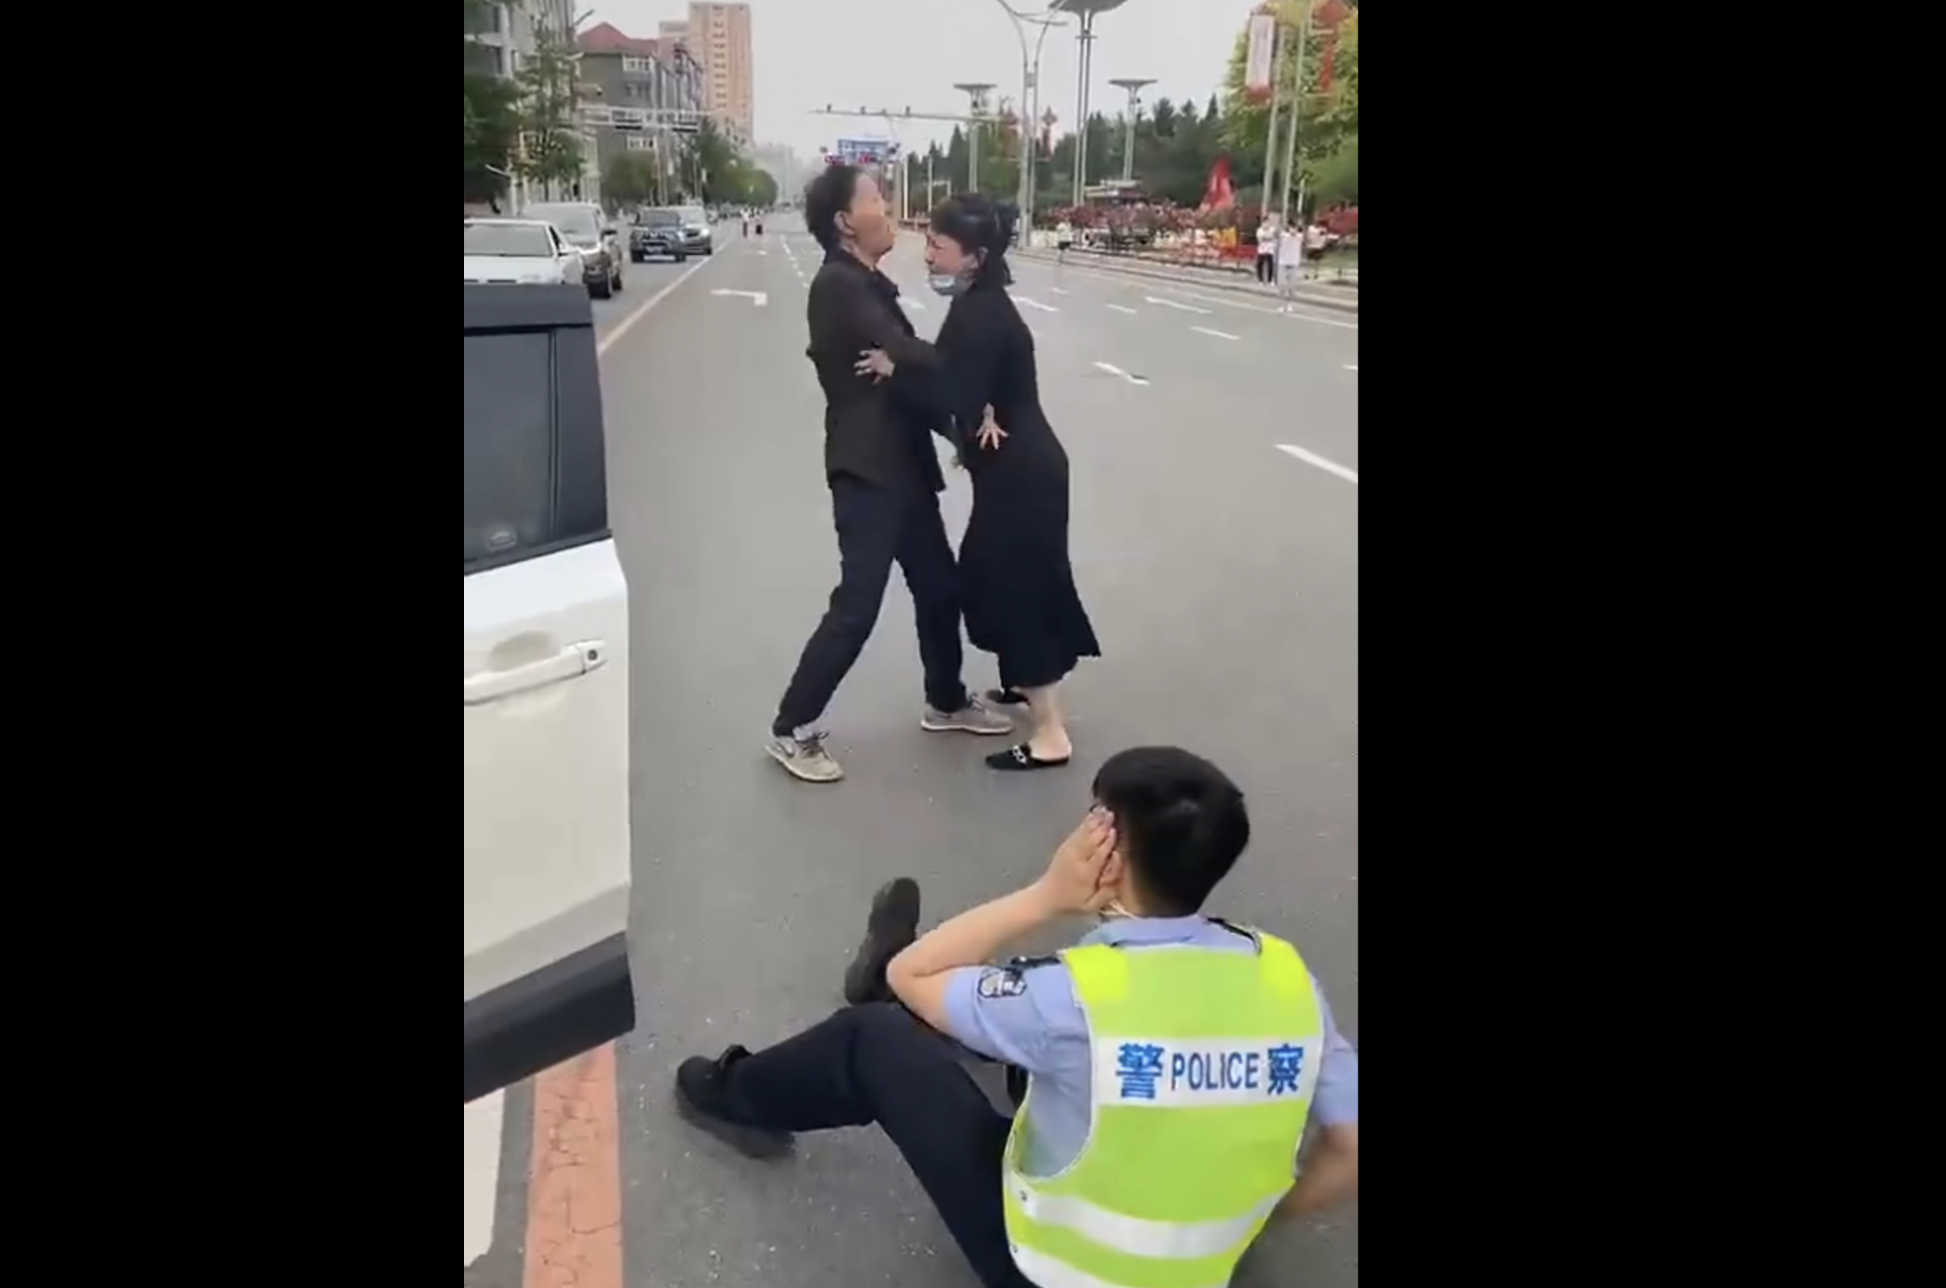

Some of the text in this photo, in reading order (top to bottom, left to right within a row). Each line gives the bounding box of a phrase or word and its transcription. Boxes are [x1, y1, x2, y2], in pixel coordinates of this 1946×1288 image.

[1115, 1043, 1304, 1099] 警 POLICE 察
